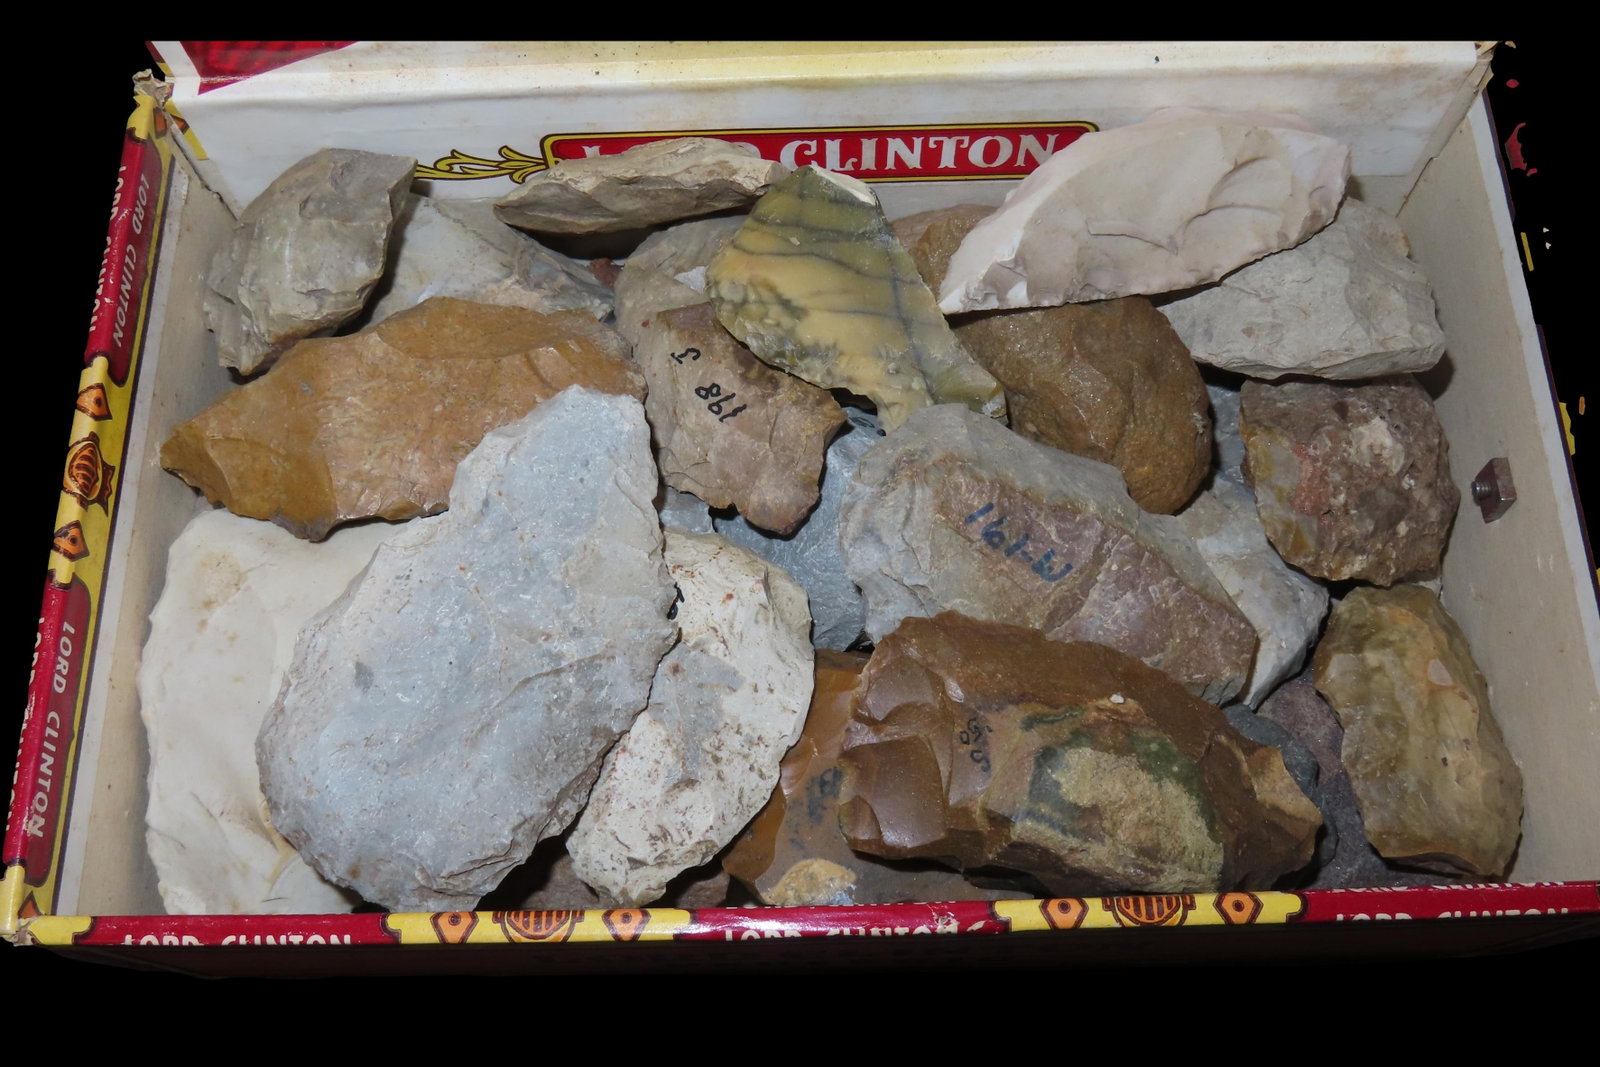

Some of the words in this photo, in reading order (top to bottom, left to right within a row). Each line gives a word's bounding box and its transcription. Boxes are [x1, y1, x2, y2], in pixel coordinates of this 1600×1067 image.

[780, 134, 1058, 173] CLINTON
[132, 172, 150, 235] LORD
[113, 244, 137, 348] CLINTON
[53, 620, 76, 694] LORD
[29, 710, 61, 838] CLINTON
